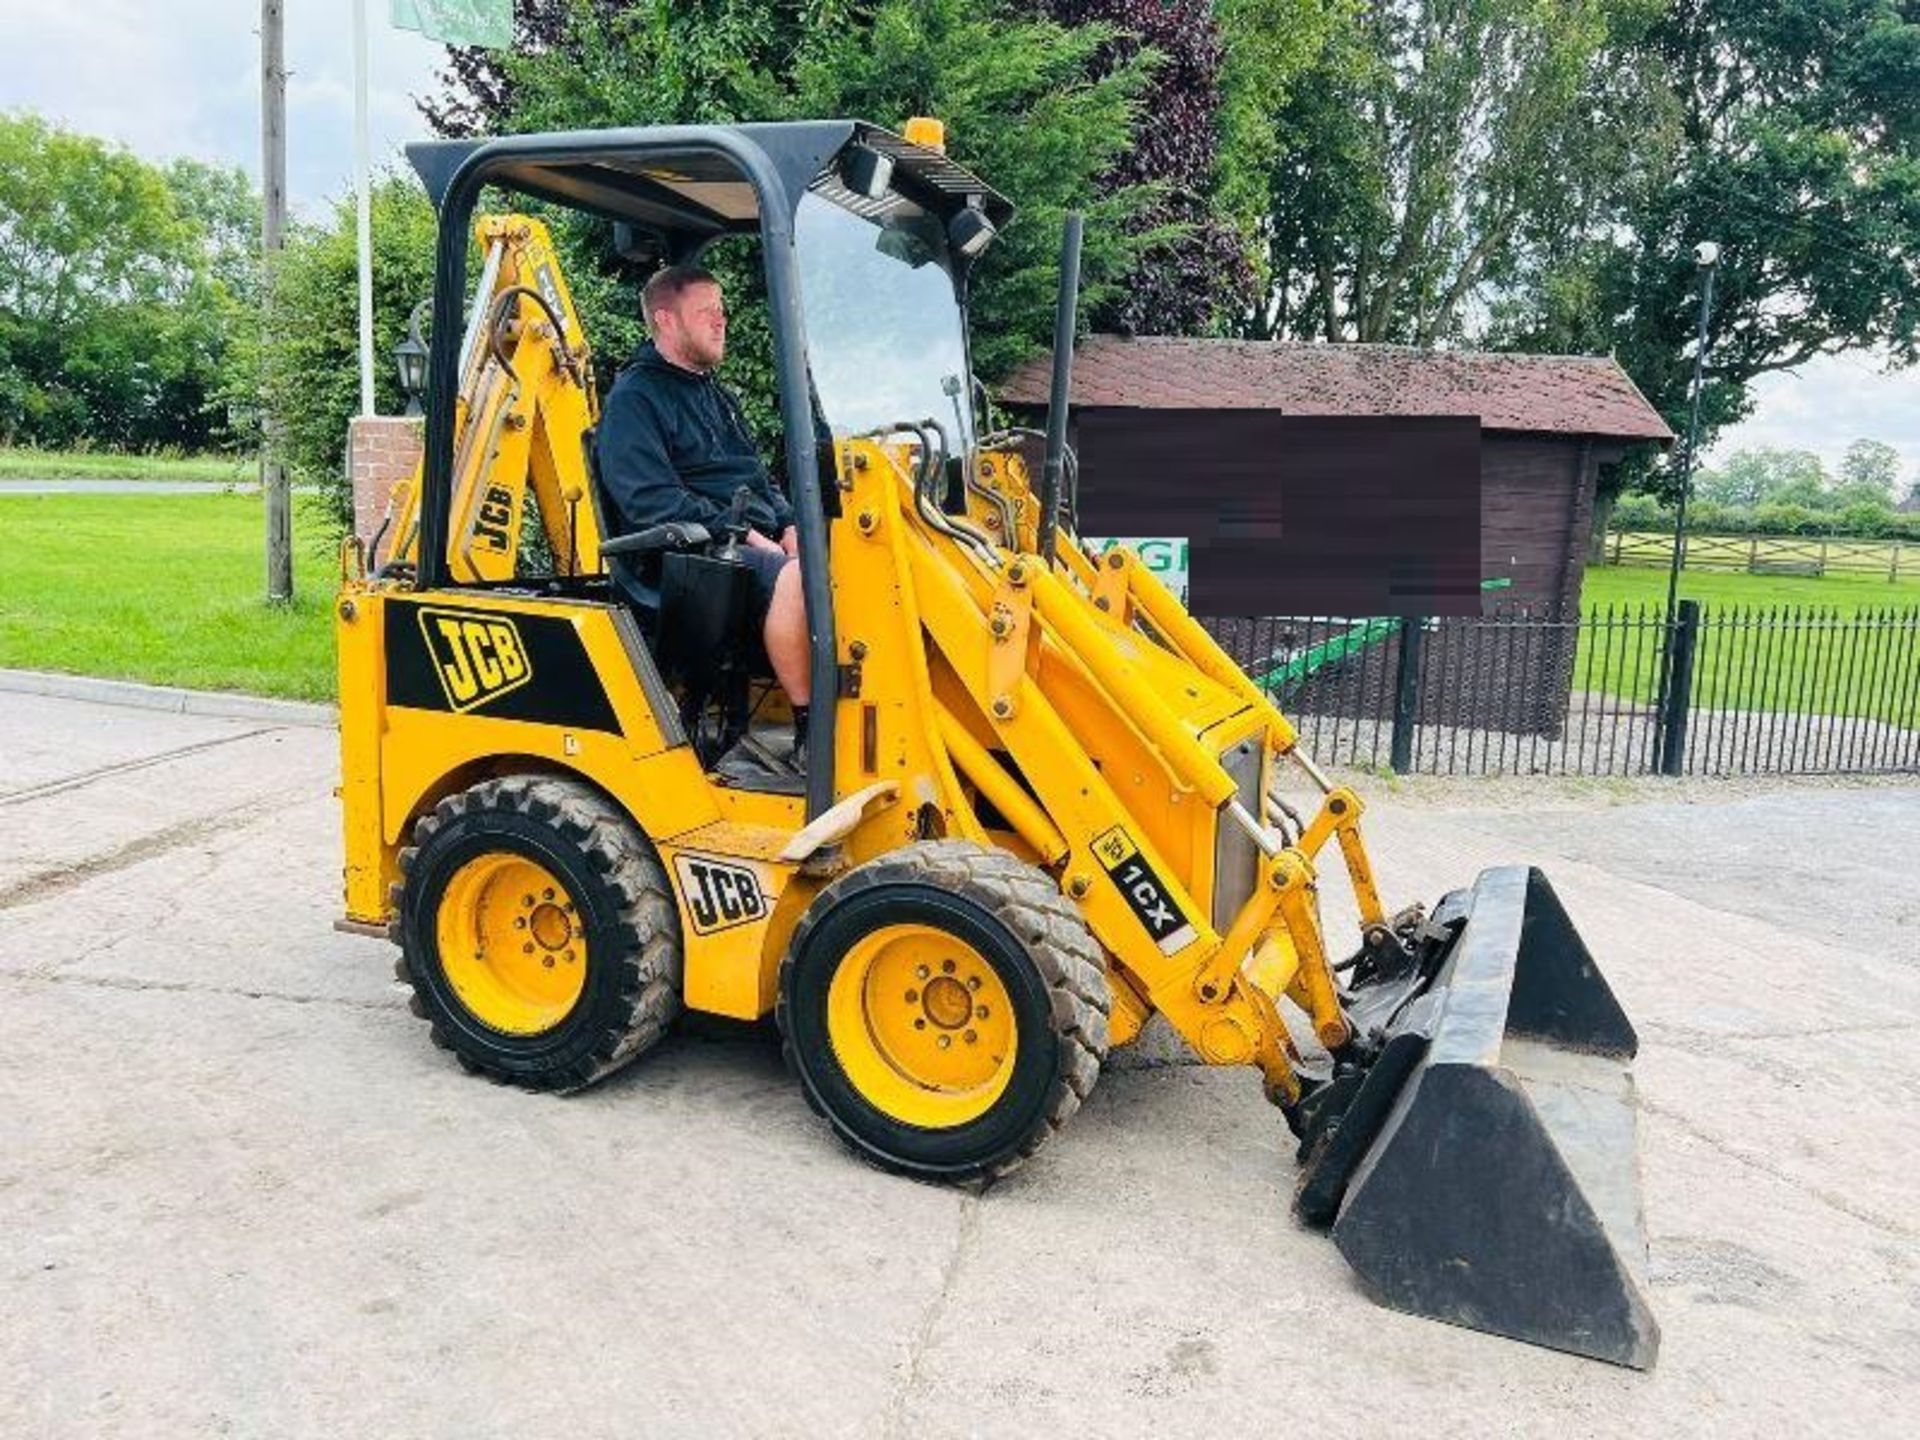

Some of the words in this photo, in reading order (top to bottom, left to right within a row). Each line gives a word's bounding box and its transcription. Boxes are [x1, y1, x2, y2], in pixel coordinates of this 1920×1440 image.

[473, 487, 511, 550] JCB
[437, 618, 524, 700] JCB
[688, 863, 760, 926] JCB
[1123, 865, 1177, 930] 1CX
